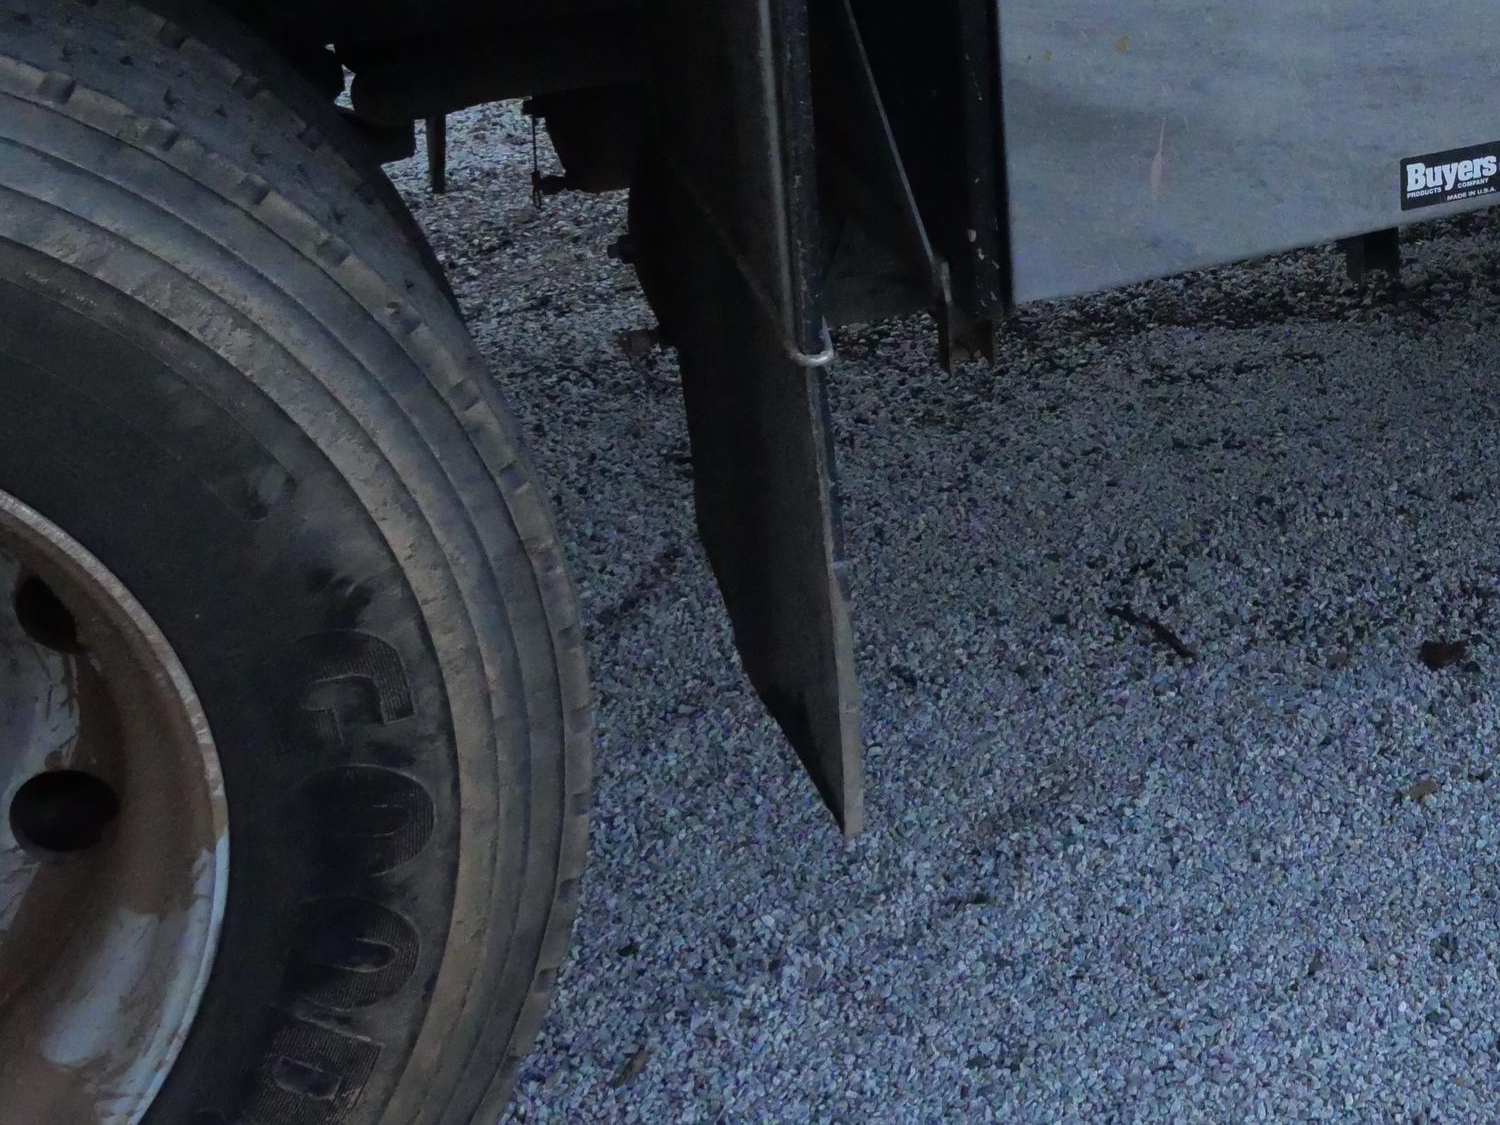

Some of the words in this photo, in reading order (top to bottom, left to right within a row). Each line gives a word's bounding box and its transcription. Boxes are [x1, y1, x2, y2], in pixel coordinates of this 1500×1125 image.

[1406, 155, 1497, 192] Buyers
[1406, 186, 1442, 199] PRODUCTS
[1457, 177, 1489, 190] COMPANY
[1446, 192, 1467, 201] MADE
[1468, 190, 1476, 198] IN
